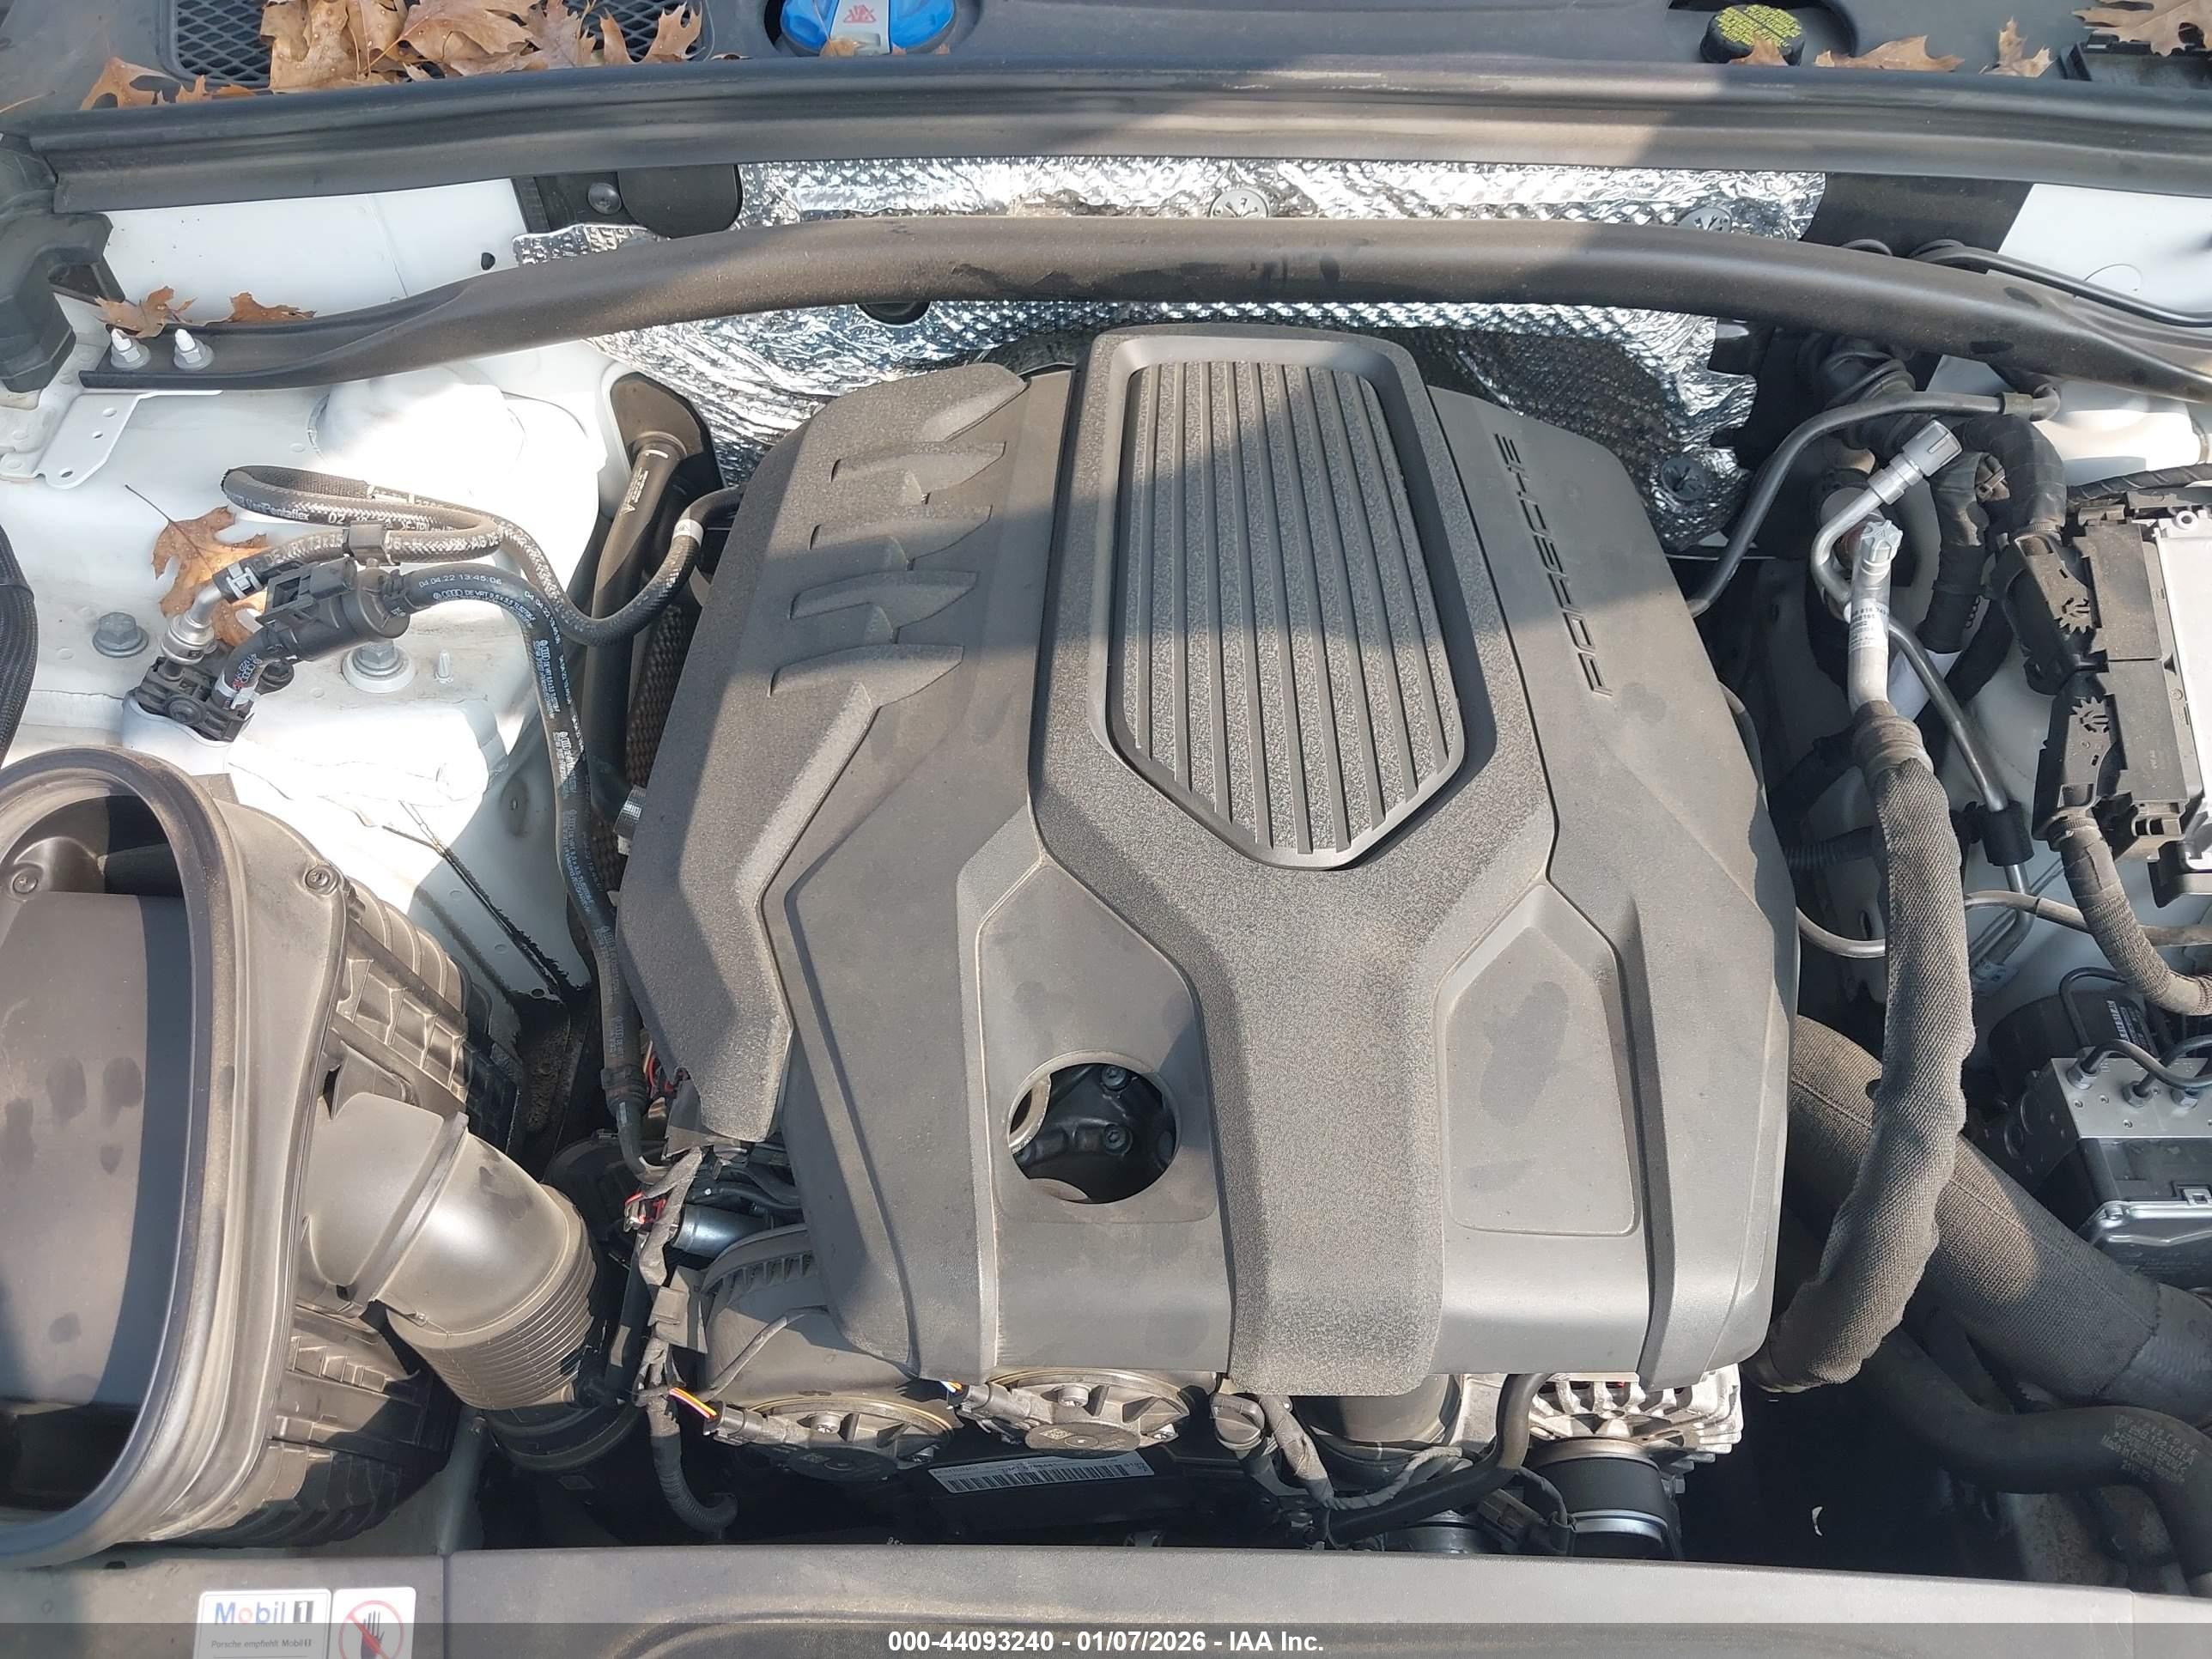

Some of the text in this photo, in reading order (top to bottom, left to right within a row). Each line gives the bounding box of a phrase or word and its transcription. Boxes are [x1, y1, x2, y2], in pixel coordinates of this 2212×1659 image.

[1494, 433, 1613, 697] PORSCHE
[215, 1601, 285, 1625] Mobil
[211, 1639, 242, 1649] Porsche
[244, 1639, 279, 1650] empfiehlt
